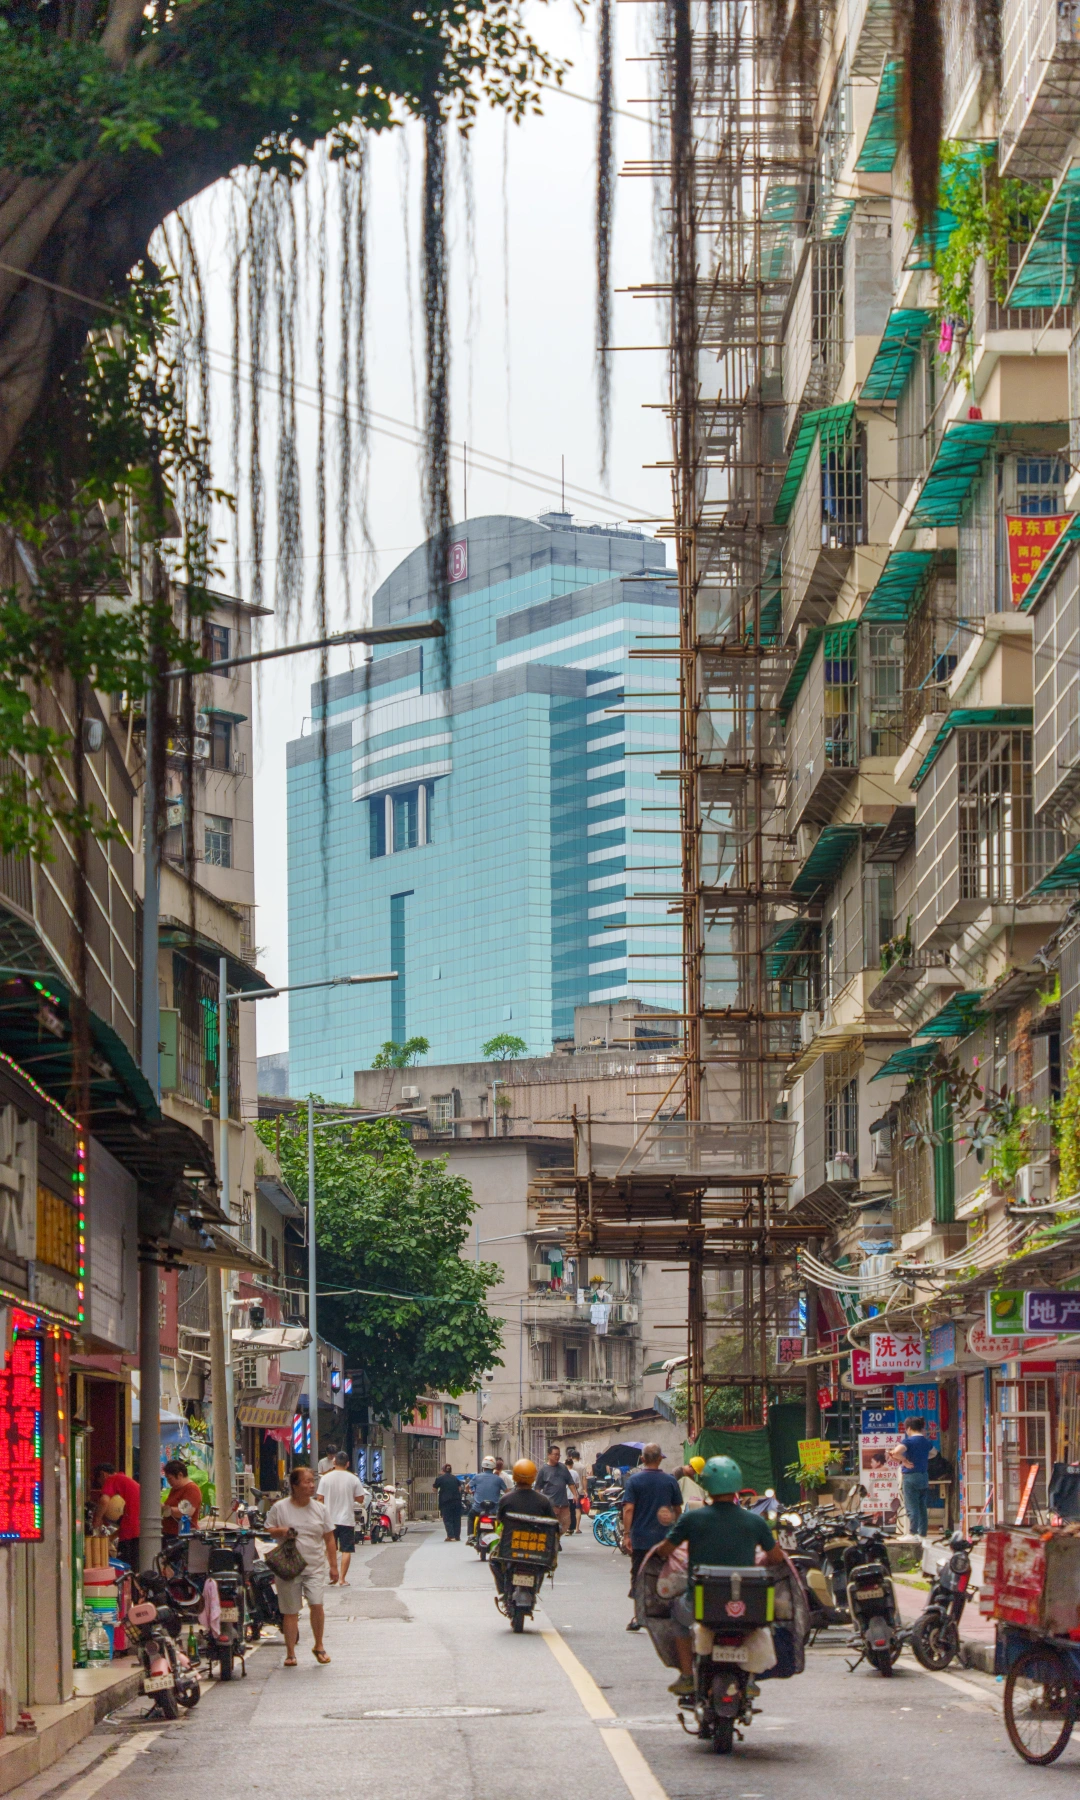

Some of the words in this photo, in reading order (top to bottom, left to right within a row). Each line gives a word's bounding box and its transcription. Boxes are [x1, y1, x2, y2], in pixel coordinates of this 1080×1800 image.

[875, 1336, 922, 1357] 洗衣
[857, 1357, 892, 1377] 推
[875, 1359, 922, 1368] Laundry
